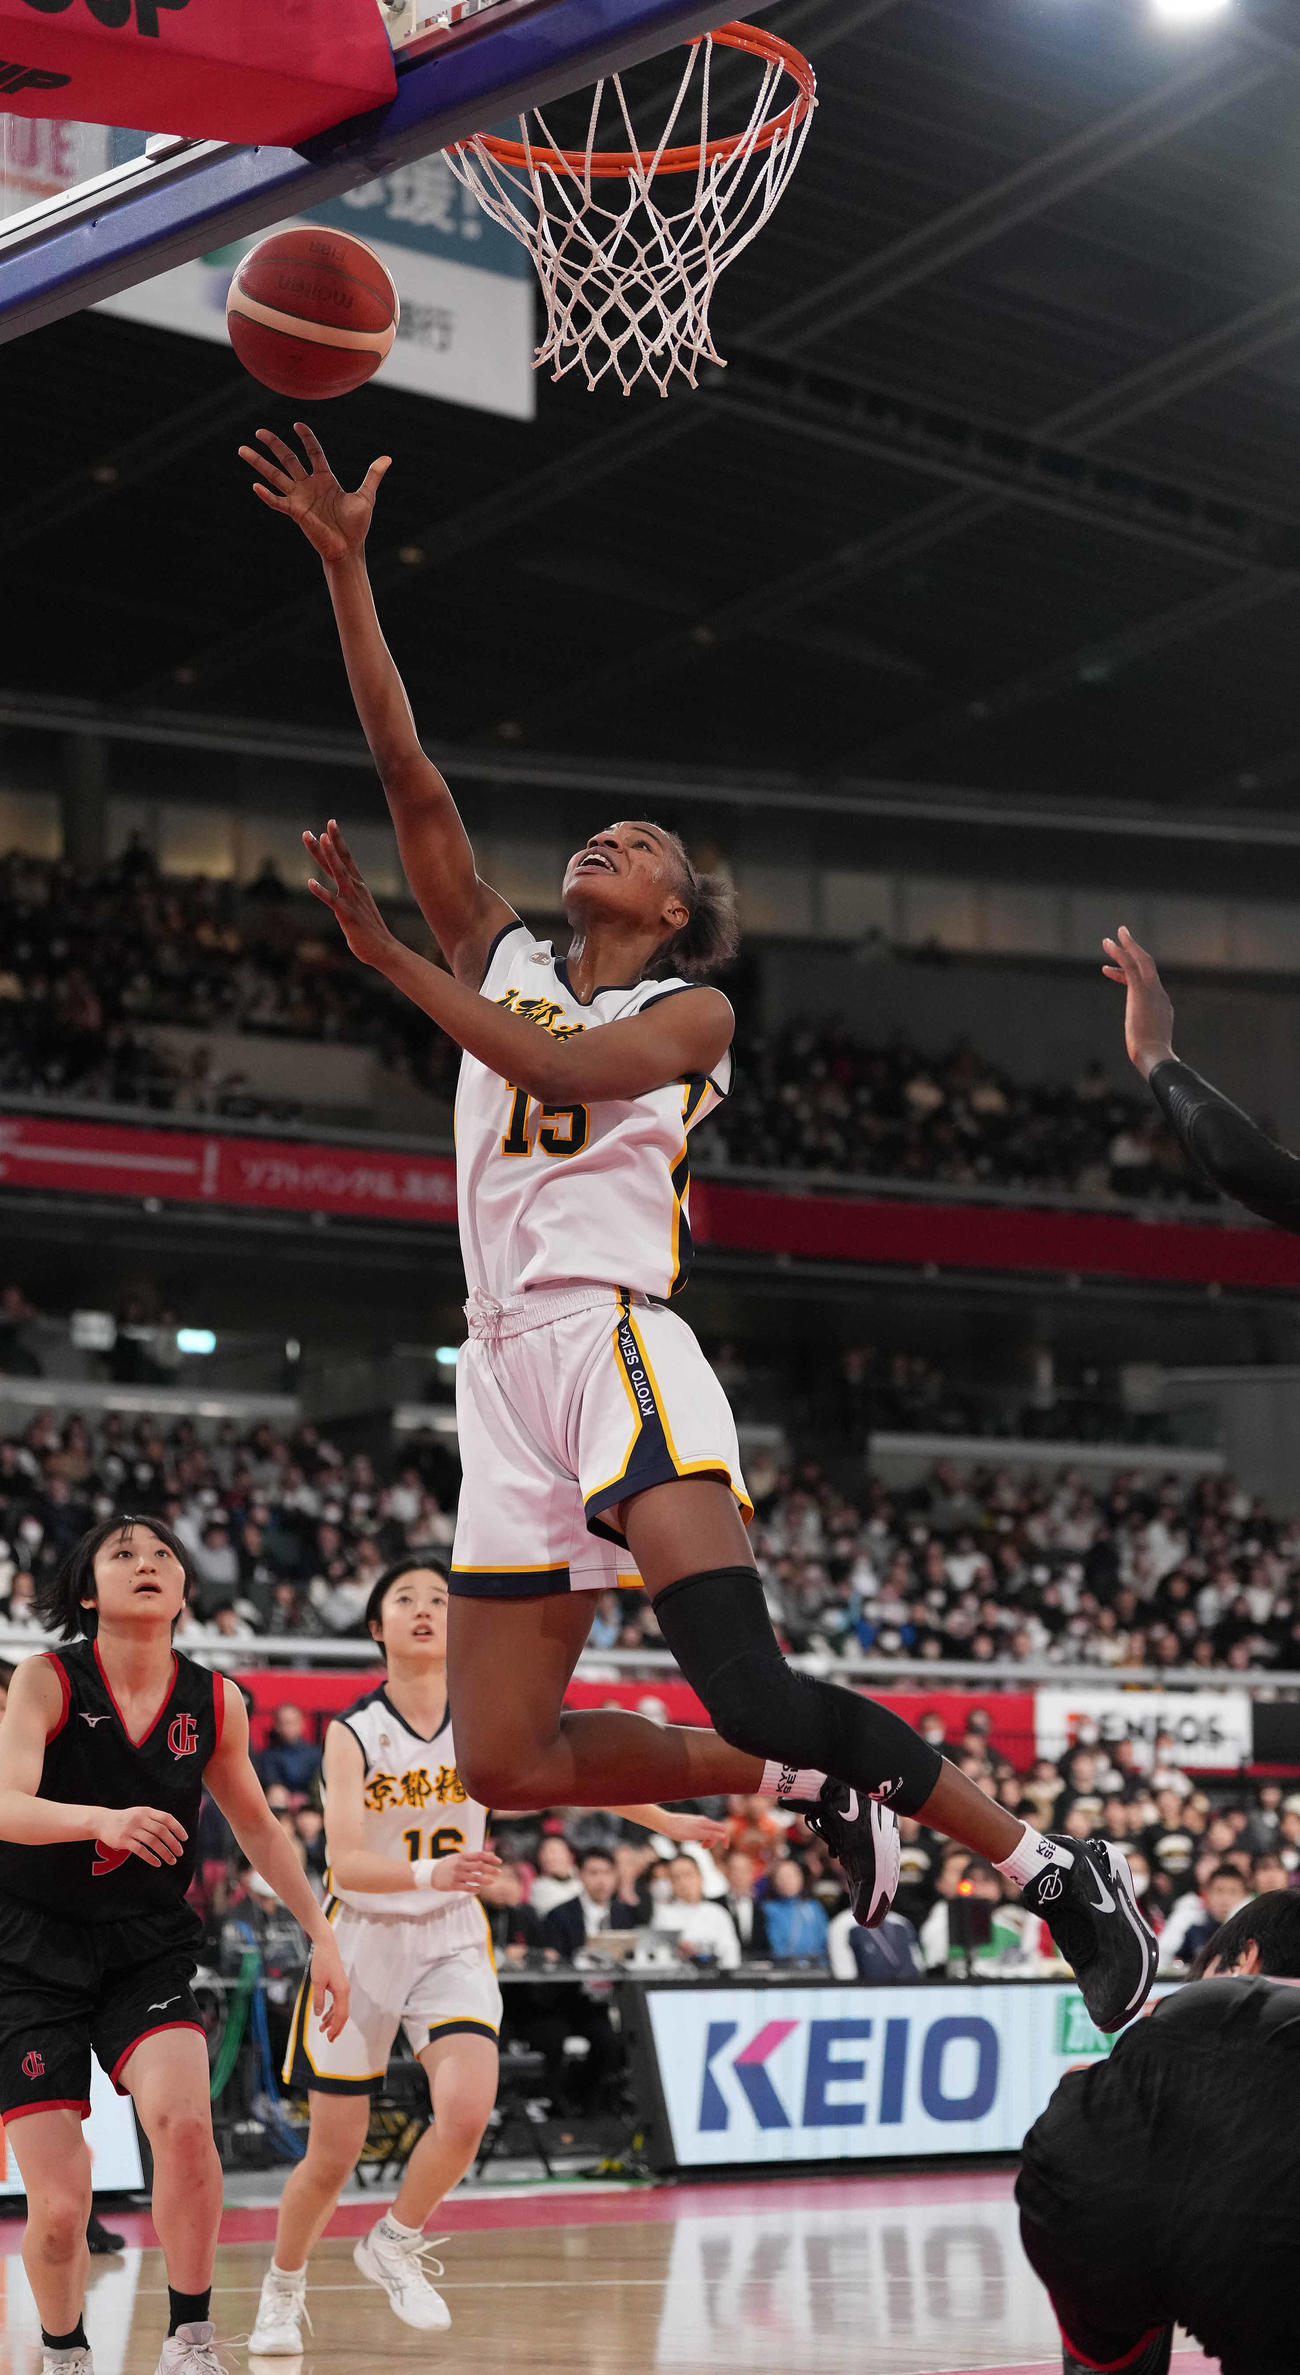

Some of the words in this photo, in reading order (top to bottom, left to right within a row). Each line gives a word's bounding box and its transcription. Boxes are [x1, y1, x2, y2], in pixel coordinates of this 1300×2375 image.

[501, 1080, 590, 1158] 15
[620, 1325, 639, 1366] SEIKA
[631, 1369, 655, 1417] KYOTO
[403, 1826, 466, 1863] 16
[698, 2016, 999, 2133] KEIO
